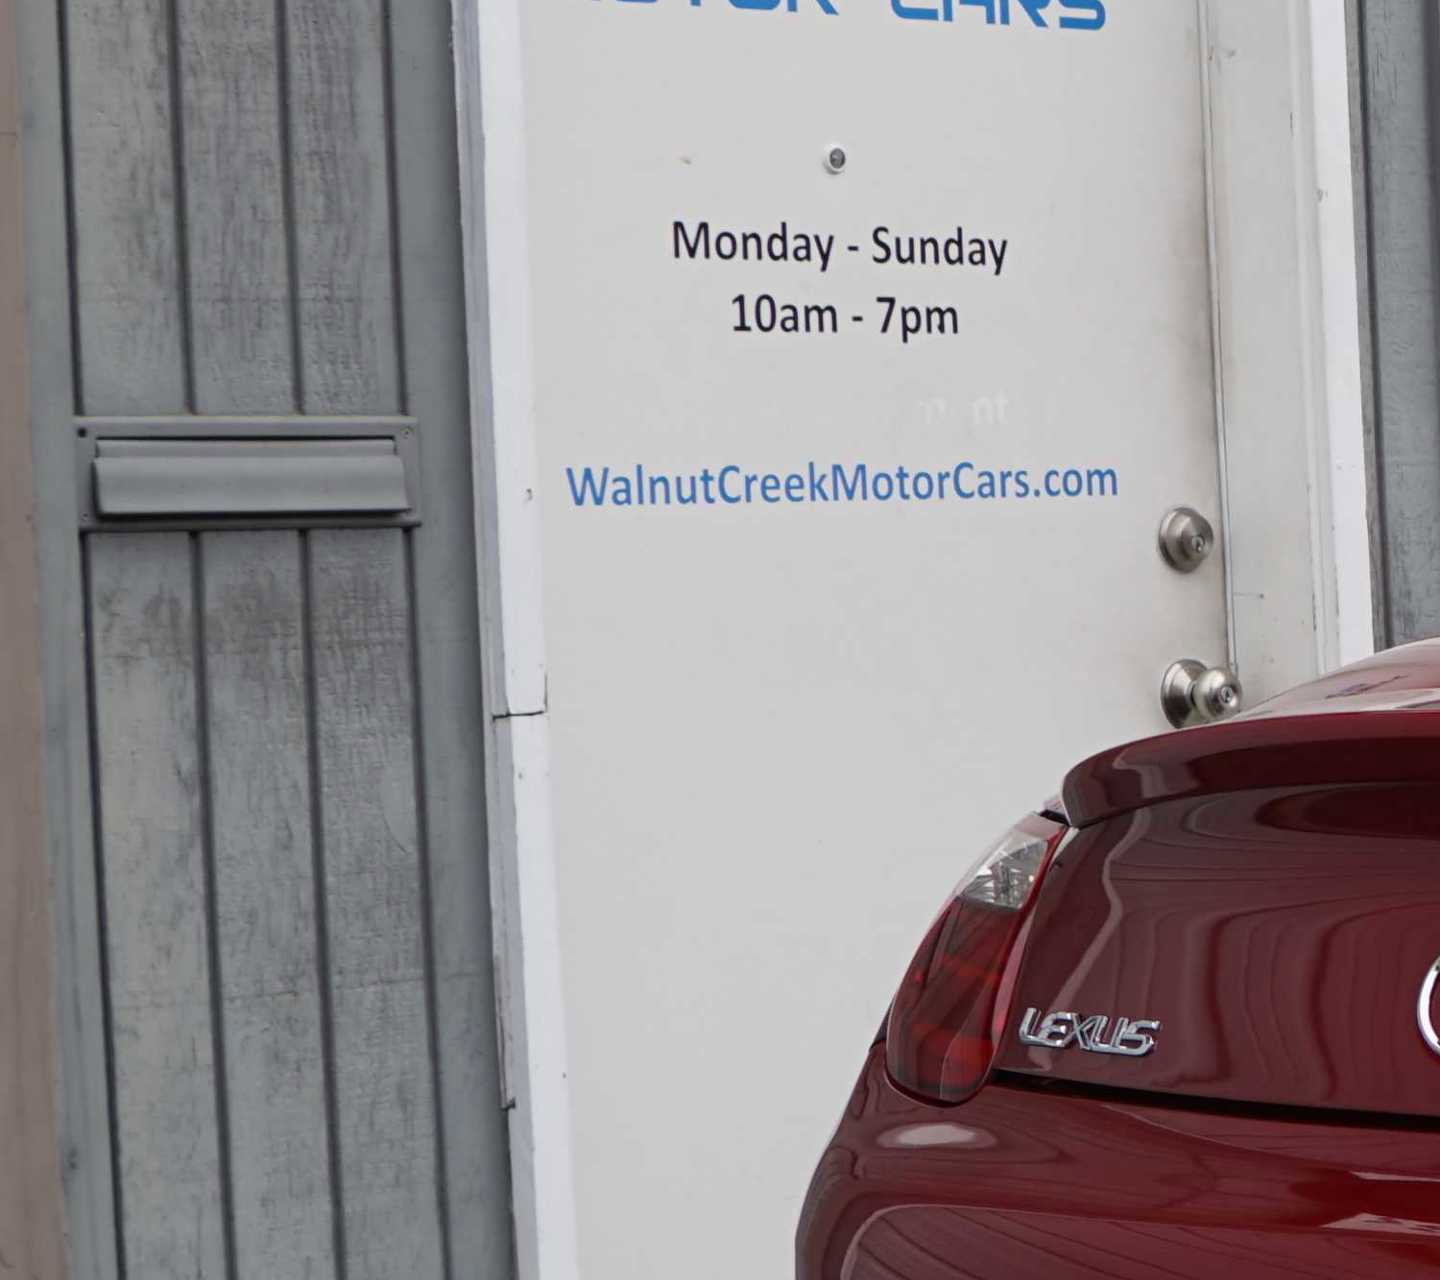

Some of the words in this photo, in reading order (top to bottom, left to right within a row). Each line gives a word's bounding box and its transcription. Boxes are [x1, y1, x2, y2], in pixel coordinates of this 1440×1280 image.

[672, 221, 835, 271] Monday
[872, 226, 1008, 275] Sunday
[731, 294, 838, 333] 10am
[877, 297, 959, 343] 7pm
[567, 461, 1118, 506] WalnutCreekMotorCars.com
[1017, 1006, 1163, 1058] LEXUS
